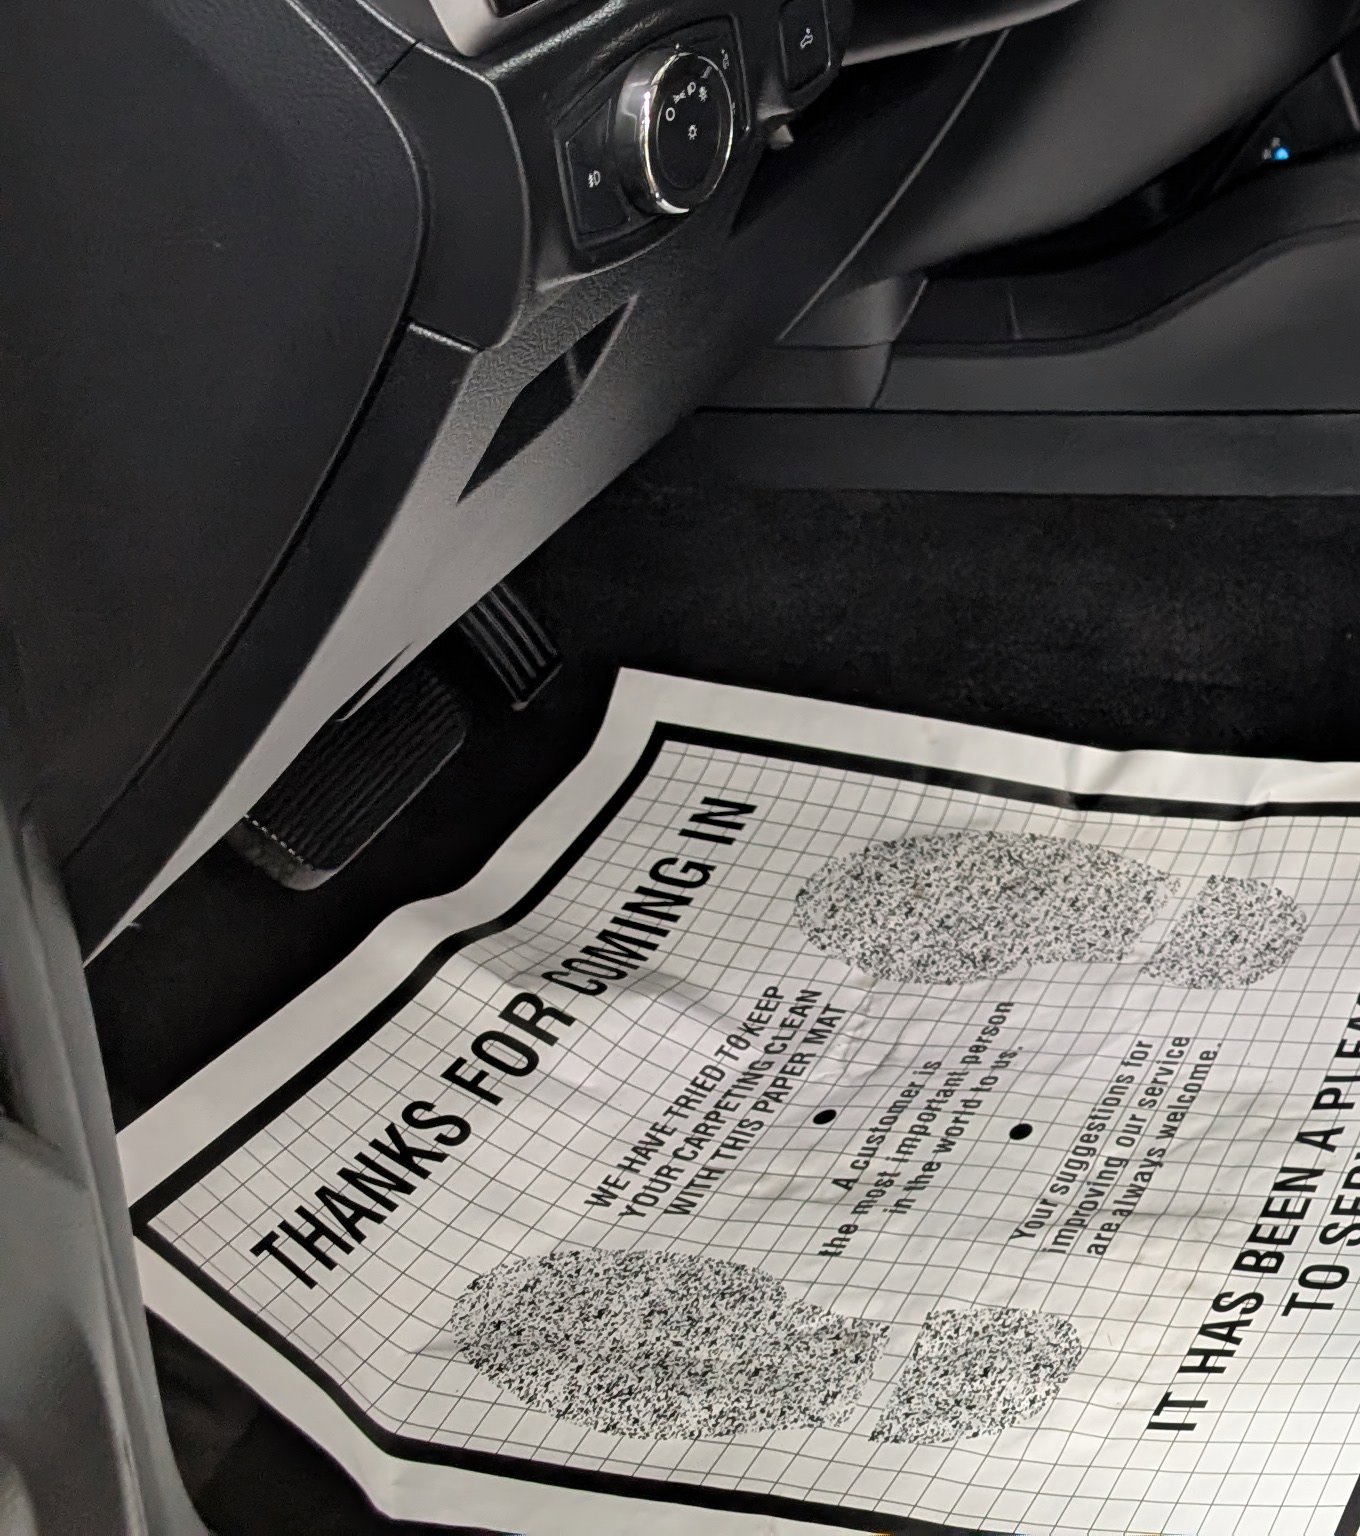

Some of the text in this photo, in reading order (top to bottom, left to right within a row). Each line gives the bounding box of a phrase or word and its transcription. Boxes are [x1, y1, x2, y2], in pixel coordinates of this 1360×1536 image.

[251, 797, 757, 1290] THANKS FOR COMING IN
[584, 986, 784, 1207] WE HAVE TRIED TO KEEP
[618, 989, 822, 1217] YOUR CARPETING CLEAN
[662, 1003, 846, 1215] WITH THIS PAPER MAT
[817, 1002, 1014, 1258] the most important person
[832, 1061, 942, 1191] A customer is
[883, 1047, 1022, 1214] in the world to us.
[1008, 1041, 1153, 1240] Your suggestions for
[1041, 1037, 1190, 1254] improving our service
[1087, 1043, 1222, 1256] are always welcome.
[1146, 1391, 1208, 1431] IT
[1177, 1291, 1264, 1374] HAS
[1232, 1166, 1325, 1274] BEEN
[1294, 1127, 1345, 1152] A
[1282, 1264, 1350, 1314] TO
